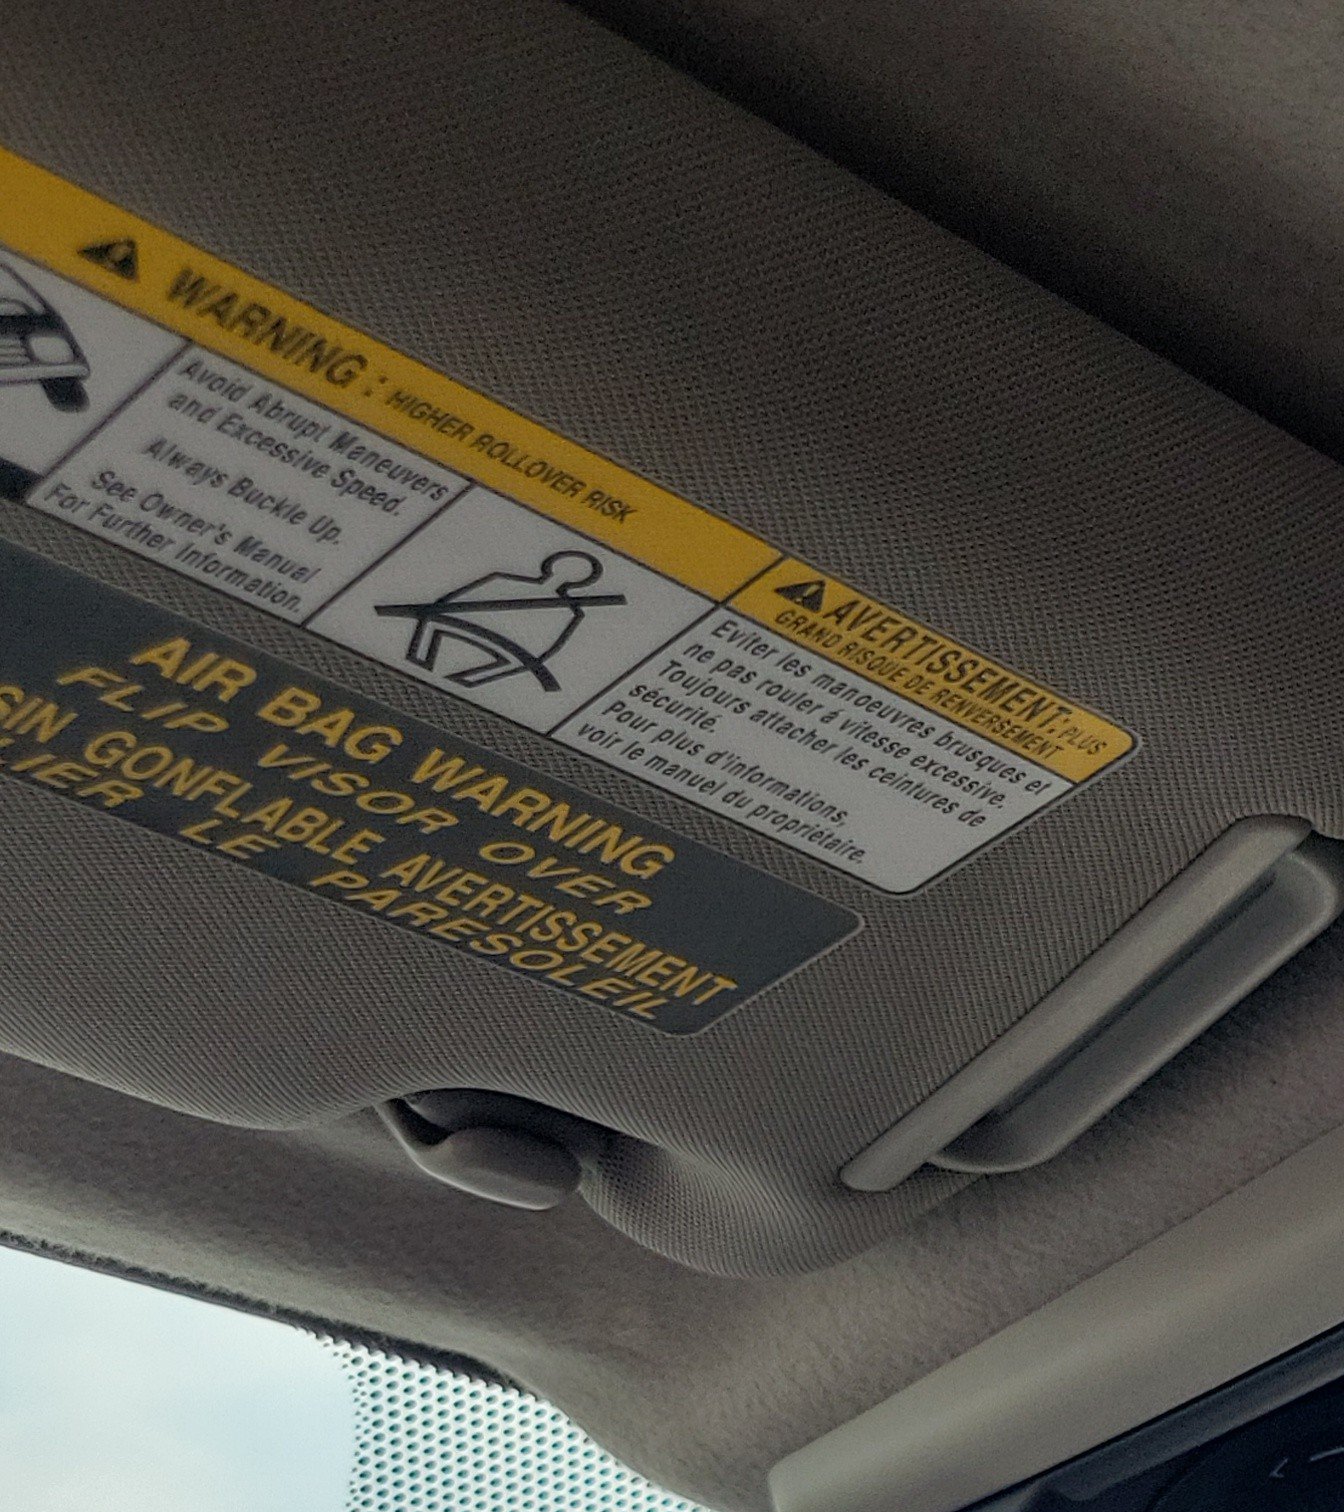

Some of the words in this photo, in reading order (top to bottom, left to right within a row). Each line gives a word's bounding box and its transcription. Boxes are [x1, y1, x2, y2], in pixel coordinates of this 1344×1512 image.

[165, 267, 368, 388] WARNING
[384, 390, 475, 442] HIGHER
[473, 432, 587, 499] ROLLOVER
[580, 489, 638, 524] RISK
[167, 391, 224, 425] and
[215, 412, 332, 479] Excessive
[330, 468, 407, 517] Speed.
[178, 358, 253, 403] Avoid
[248, 393, 332, 443] Abrupt
[329, 430, 450, 502] Maneuvers
[43, 480, 90, 514] For
[88, 502, 176, 551] Further
[175, 541, 303, 613] Information.
[91, 468, 139, 503] See
[139, 493, 233, 546] Owner's
[233, 535, 322, 584] Manual
[141, 436, 230, 488] Always
[227, 477, 309, 527] Buckle
[308, 515, 342, 545] Up.
[600, 701, 659, 735] Pour
[650, 728, 705, 757] plus
[627, 683, 722, 734] sécurité.
[658, 660, 752, 715] Toujours
[749, 708, 838, 755] attacher
[833, 746, 870, 772] les
[867, 764, 961, 817] ceintures
[958, 808, 986, 829] de
[682, 642, 716, 664] ne
[711, 657, 759, 686] pas
[755, 678, 825, 714] rouler
[838, 715, 912, 760] vitesse
[774, 609, 840, 649] GRAND
[837, 640, 908, 683] RISQUE
[902, 674, 932, 696] DE
[930, 687, 1066, 761] RENVERSEMENT
[775, 653, 813, 679] les
[811, 671, 937, 739] manoeuvres
[933, 730, 1028, 785] brusques
[1023, 774, 1051, 796] et
[1058, 726, 1109, 757] PLUS
[56, 666, 230, 734] FLIP
[257, 742, 460, 836] VISOR
[478, 840, 653, 916] OVER
[131, 636, 258, 703] AIR
[256, 686, 405, 765] BAG
[410, 747, 676, 880] WARNING
[577, 723, 624, 750] voir
[622, 741, 645, 761] le
[645, 755, 725, 797] manuel
[721, 786, 753, 810] du
[83, 730, 387, 866] GONFLABLE
[378, 853, 740, 1006] AVERTISSEMENT
[178, 818, 282, 860] LE
[308, 868, 671, 1020] PARESOLEIL
